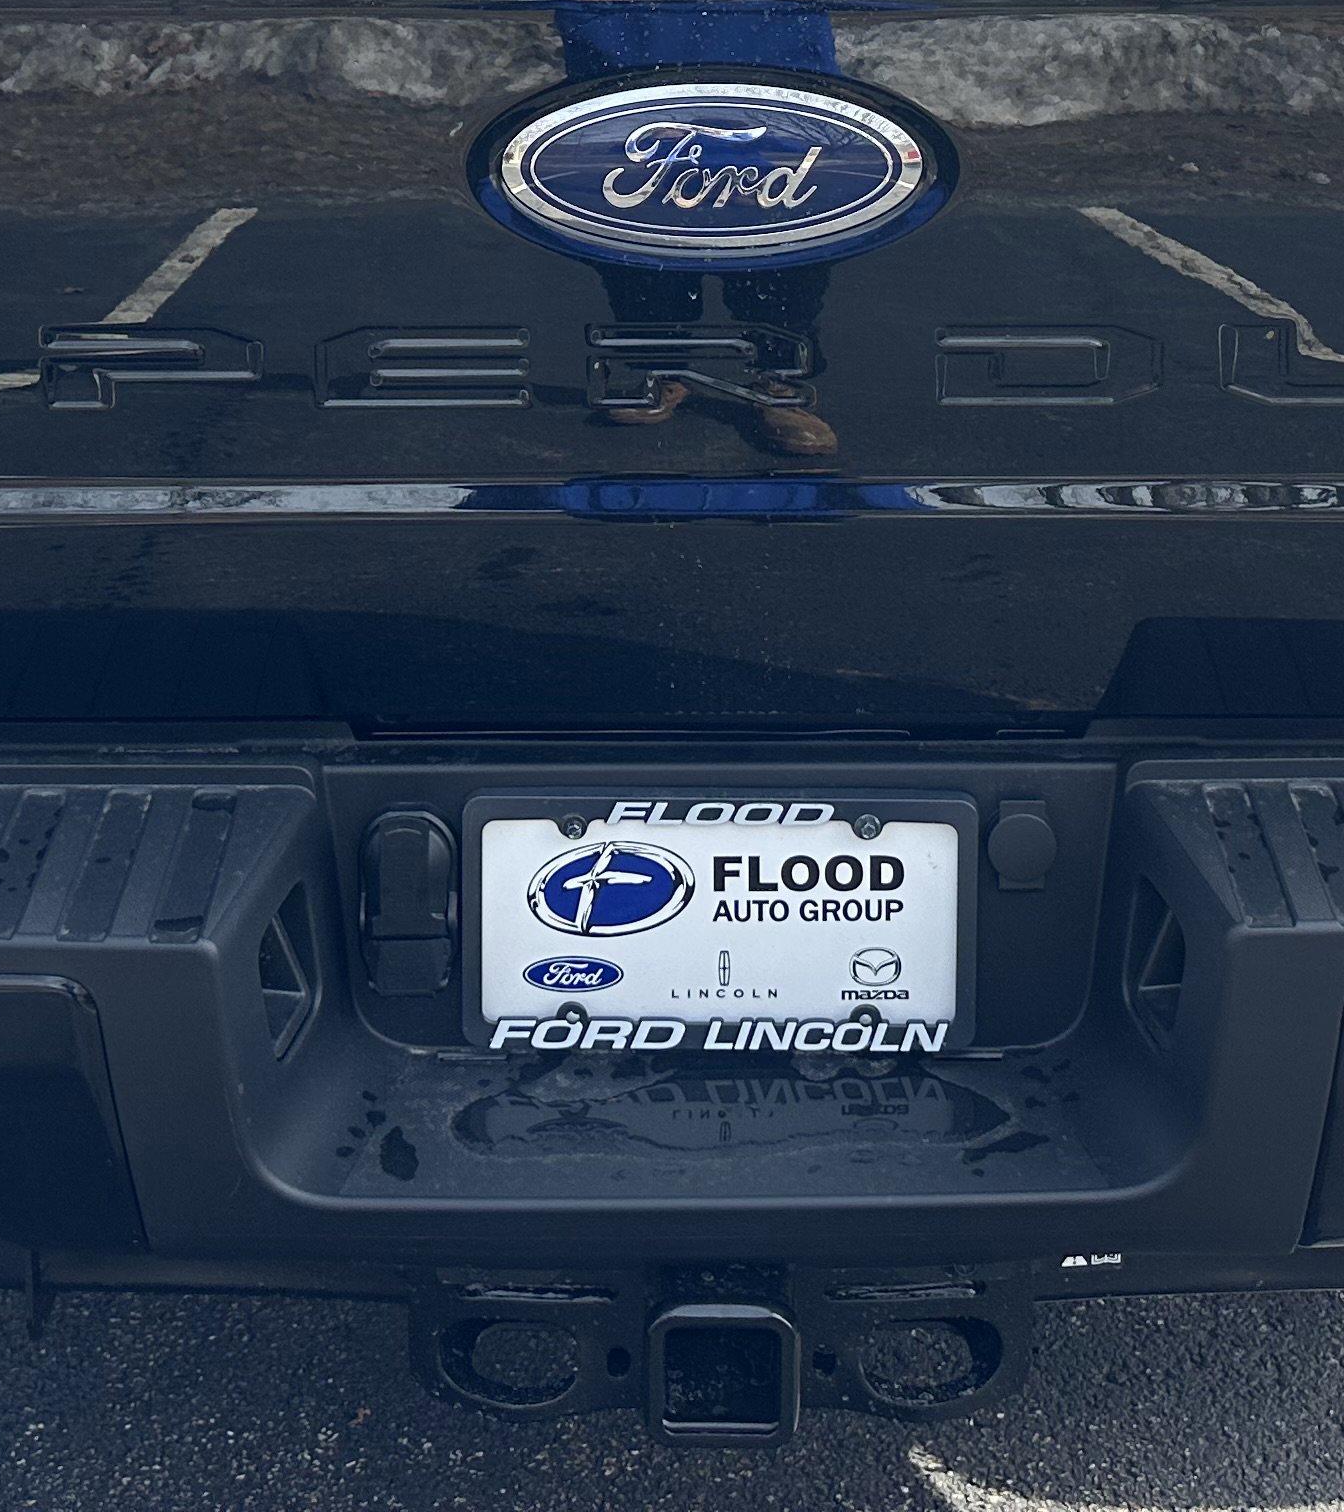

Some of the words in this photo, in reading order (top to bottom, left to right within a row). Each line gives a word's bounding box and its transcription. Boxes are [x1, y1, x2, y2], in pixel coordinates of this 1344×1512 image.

[602, 121, 822, 209] Ford
[605, 801, 835, 827] FLOOD
[713, 855, 906, 893] FLOOD
[712, 899, 789, 922] AUTO
[799, 899, 905, 922] GROUP
[542, 961, 604, 987] Ford
[671, 988, 778, 1000] LINCOLN
[841, 988, 910, 1001] mazda
[489, 1019, 686, 1051] FORD
[703, 1020, 949, 1052] LINCOLN
